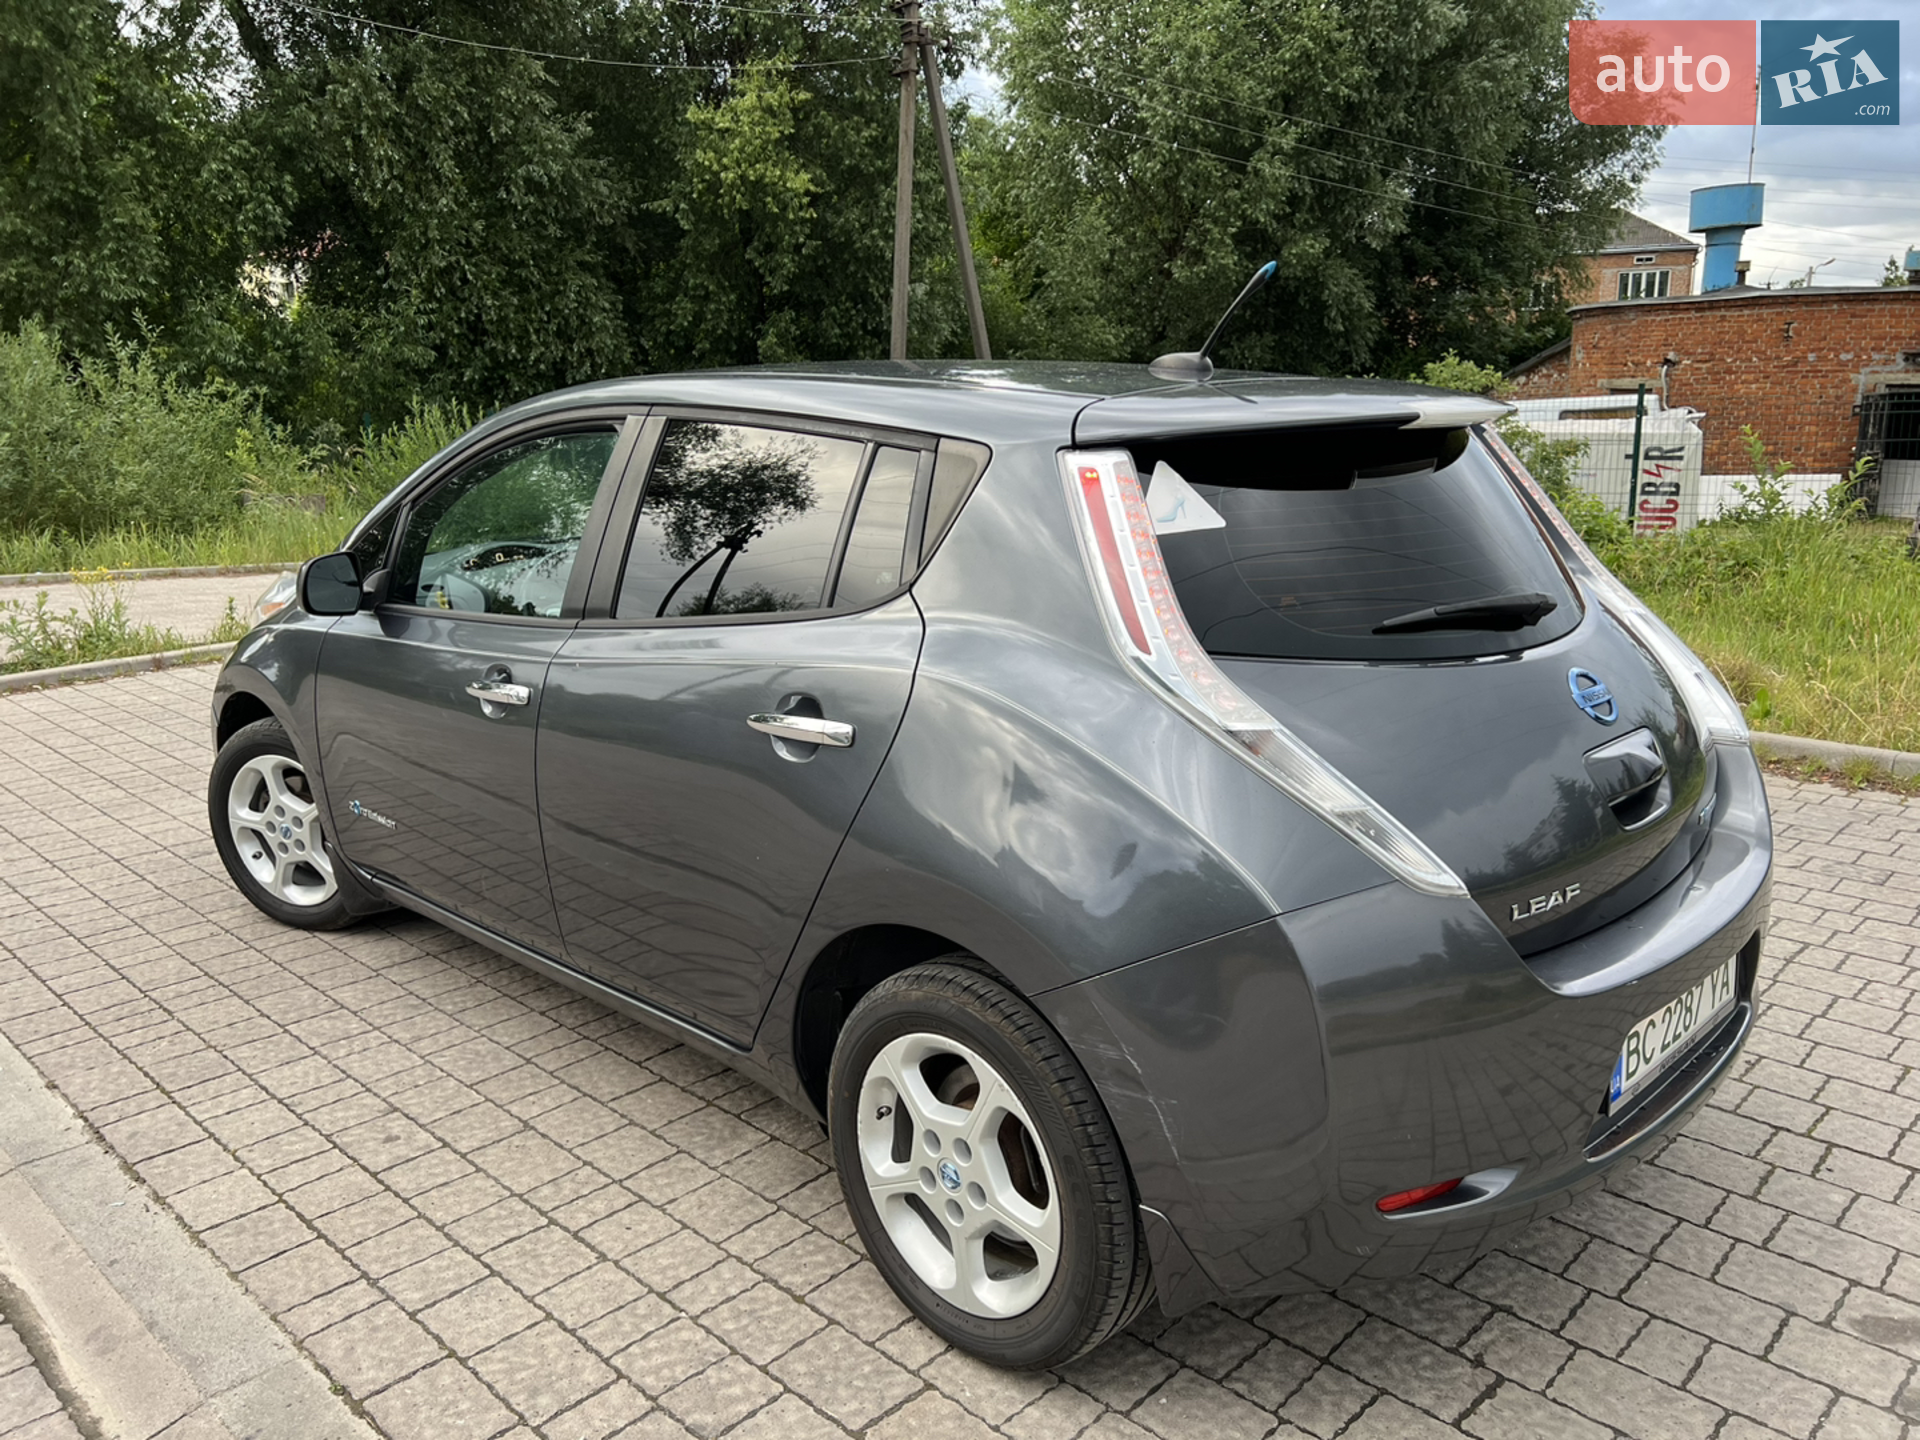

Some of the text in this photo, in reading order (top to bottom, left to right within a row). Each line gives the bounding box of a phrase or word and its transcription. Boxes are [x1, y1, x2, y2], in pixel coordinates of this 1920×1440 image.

[1510, 882, 1581, 921] LEAF
[1625, 961, 1730, 1082] BC 2287 YA
